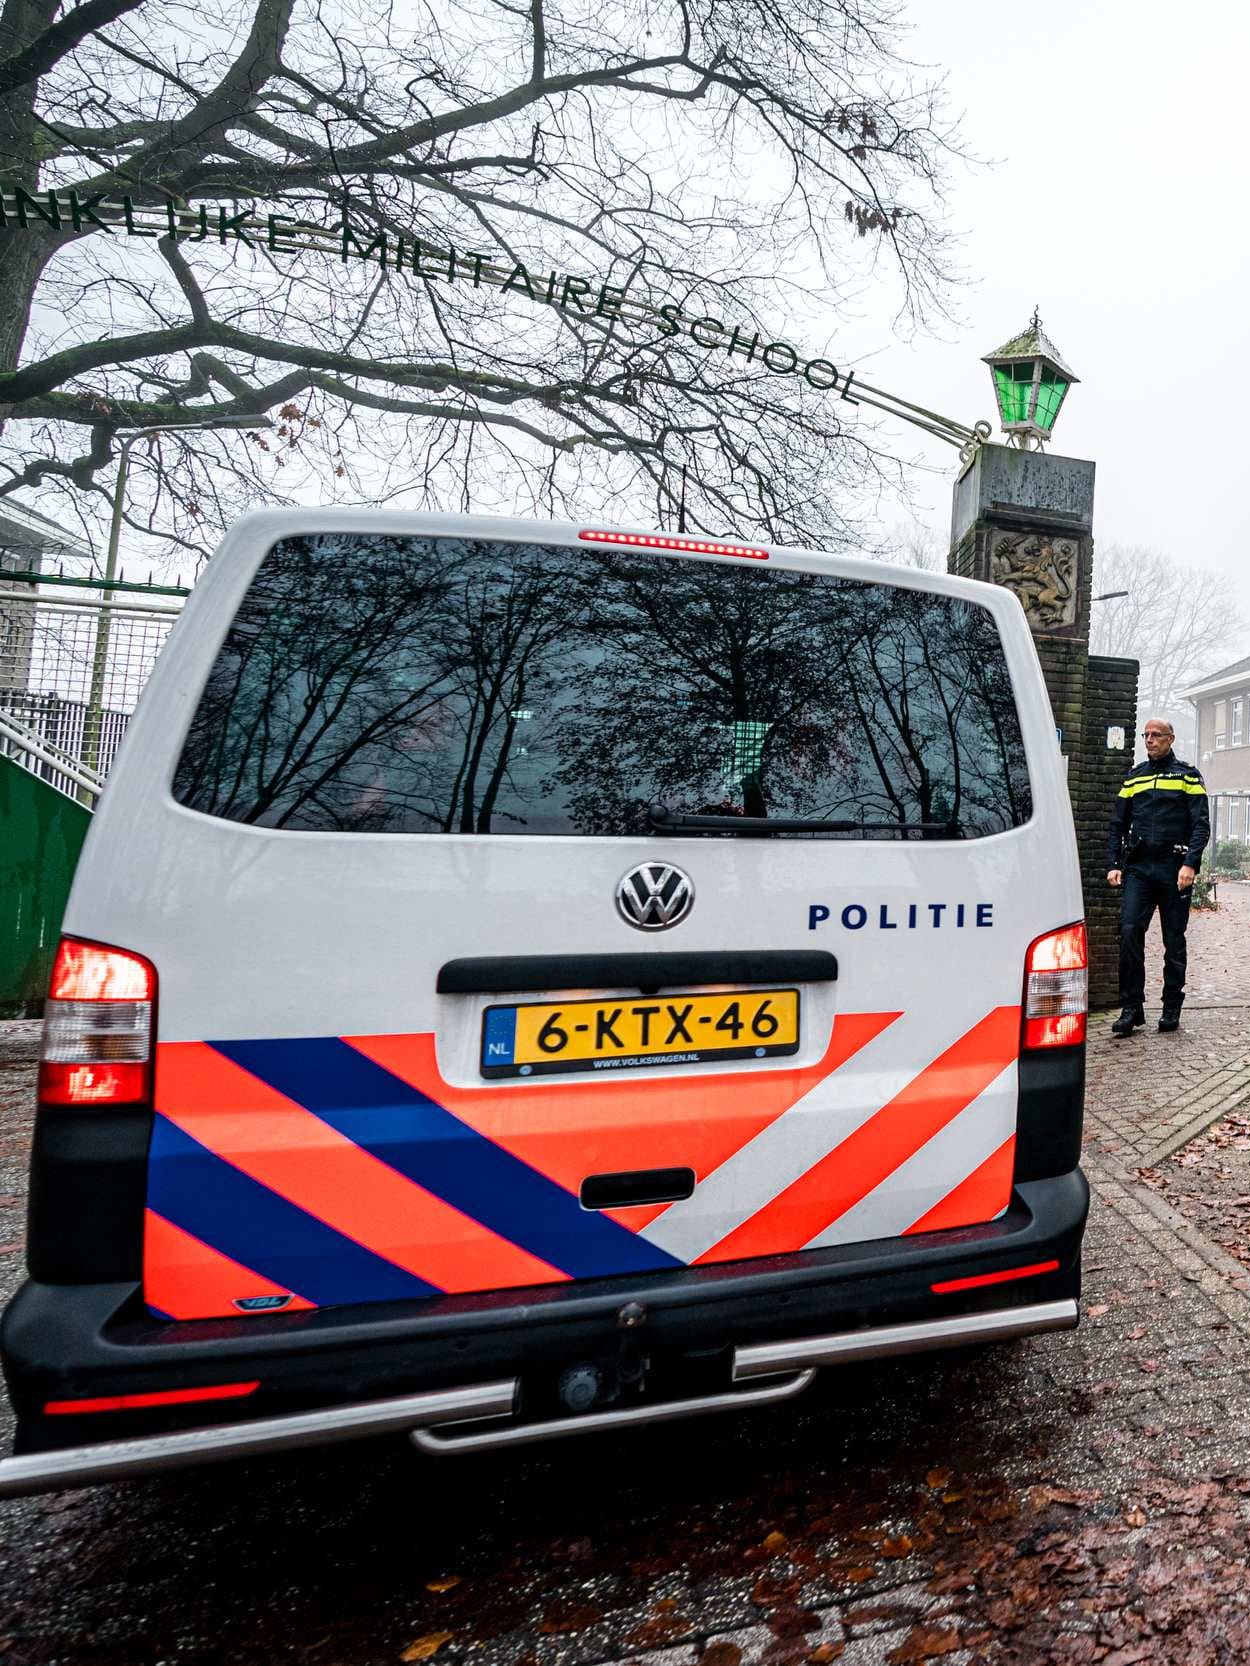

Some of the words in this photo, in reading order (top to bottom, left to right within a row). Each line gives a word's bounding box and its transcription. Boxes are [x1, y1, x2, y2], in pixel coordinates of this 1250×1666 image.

[341, 224, 625, 322] MILITAIRE
[657, 304, 861, 405] SCHOOL
[808, 903, 995, 930] POLITIE
[488, 1042, 510, 1055] NL
[536, 999, 779, 1054] 6-KTX-46
[593, 1052, 700, 1069] WWW.VOLKSWAGEN.NL
